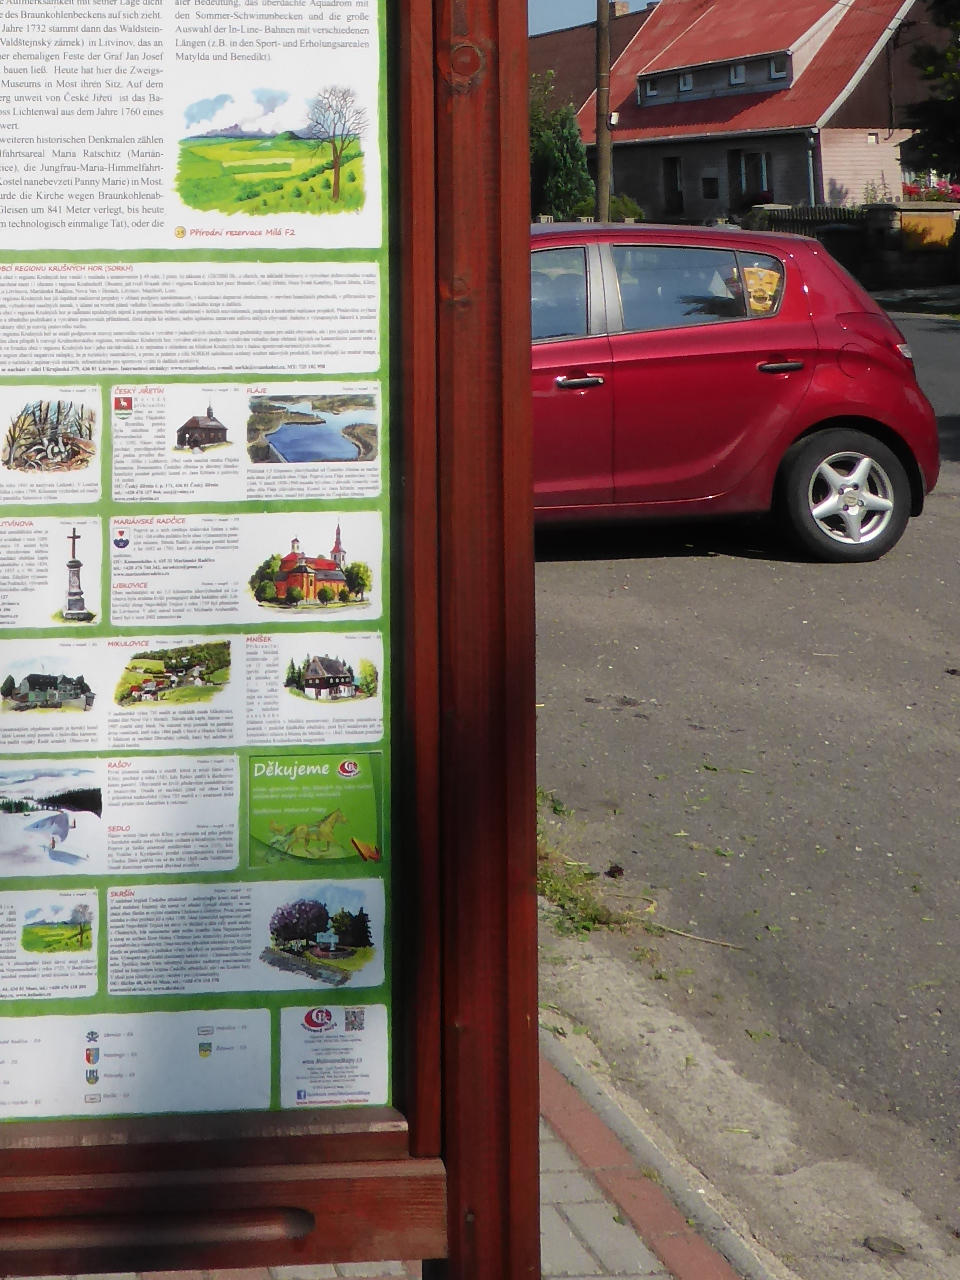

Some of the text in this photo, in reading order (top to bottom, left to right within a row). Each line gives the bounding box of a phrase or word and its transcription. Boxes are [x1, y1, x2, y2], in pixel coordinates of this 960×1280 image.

[190, 228, 222, 237] Přírodní
[265, 228, 282, 236] Milá
[284, 228, 296, 236] F2
[48, 264, 86, 272] KRUŠNÝCH
[104, 265, 134, 273] (SORKH)
[114, 386, 164, 395] ČESKÝ JIŘETÍN
[113, 516, 186, 525] MARIÁNSKÉ RADČICE
[107, 760, 132, 768] RAŠOV
[253, 760, 330, 781] Děkujeme
[107, 825, 131, 834] SEDLO
